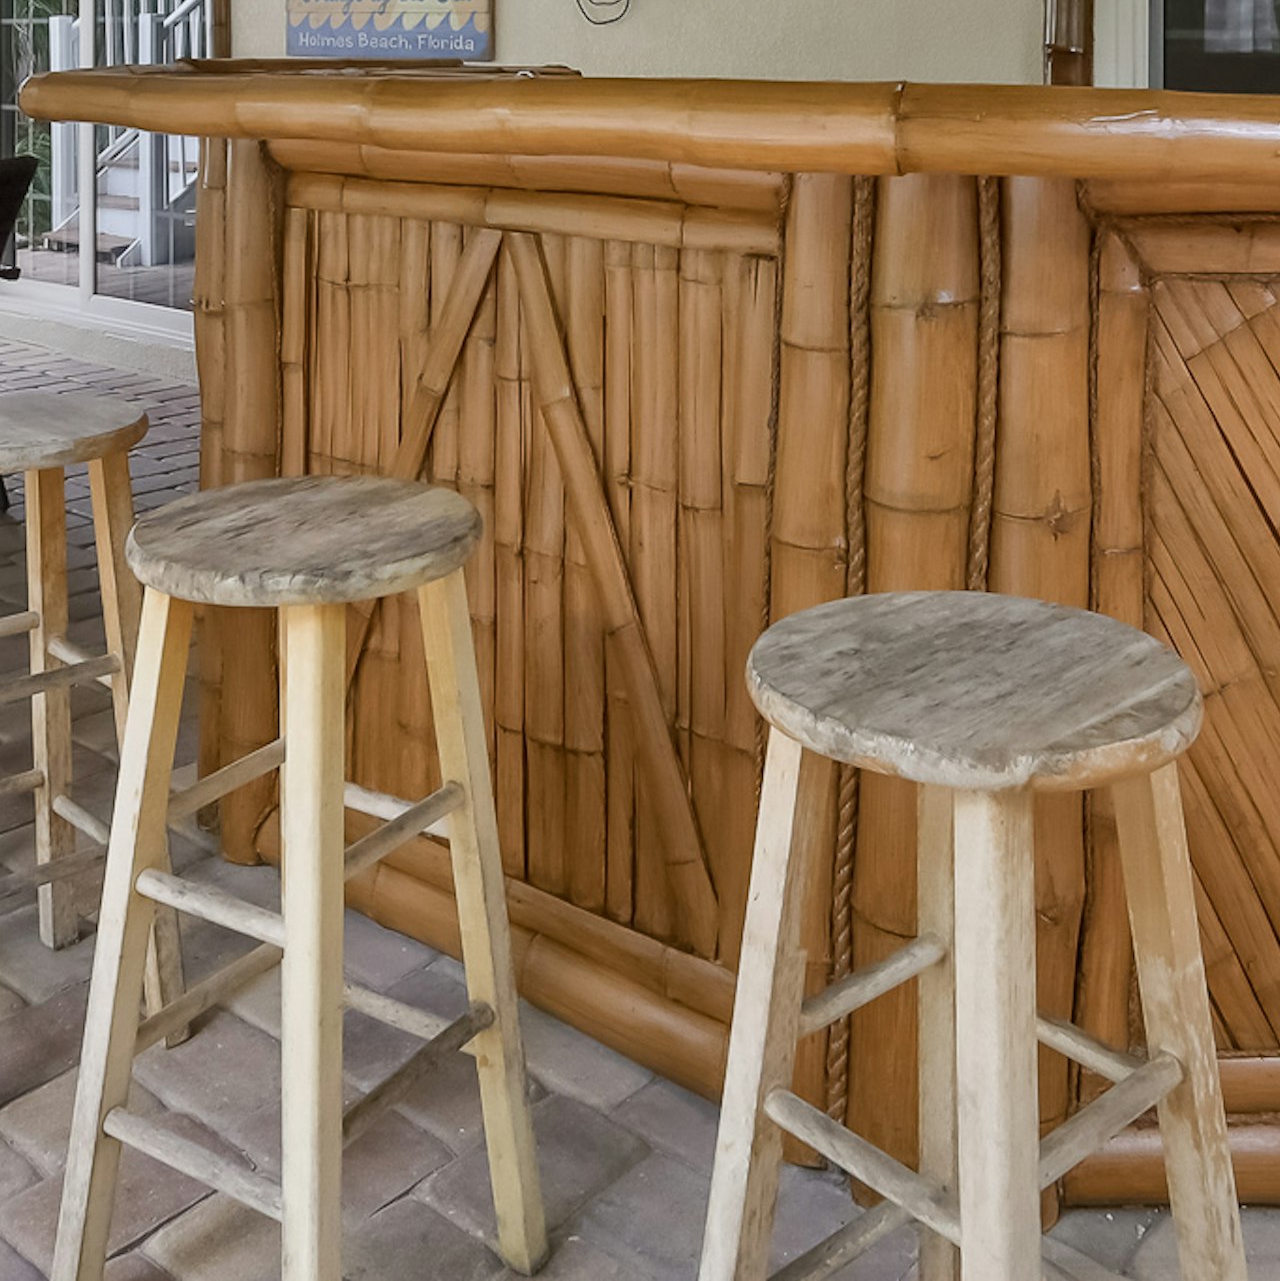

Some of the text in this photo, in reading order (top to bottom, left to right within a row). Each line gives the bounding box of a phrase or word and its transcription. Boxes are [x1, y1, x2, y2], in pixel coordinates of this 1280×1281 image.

[298, 31, 474, 52] Holmes Beach, Florida
